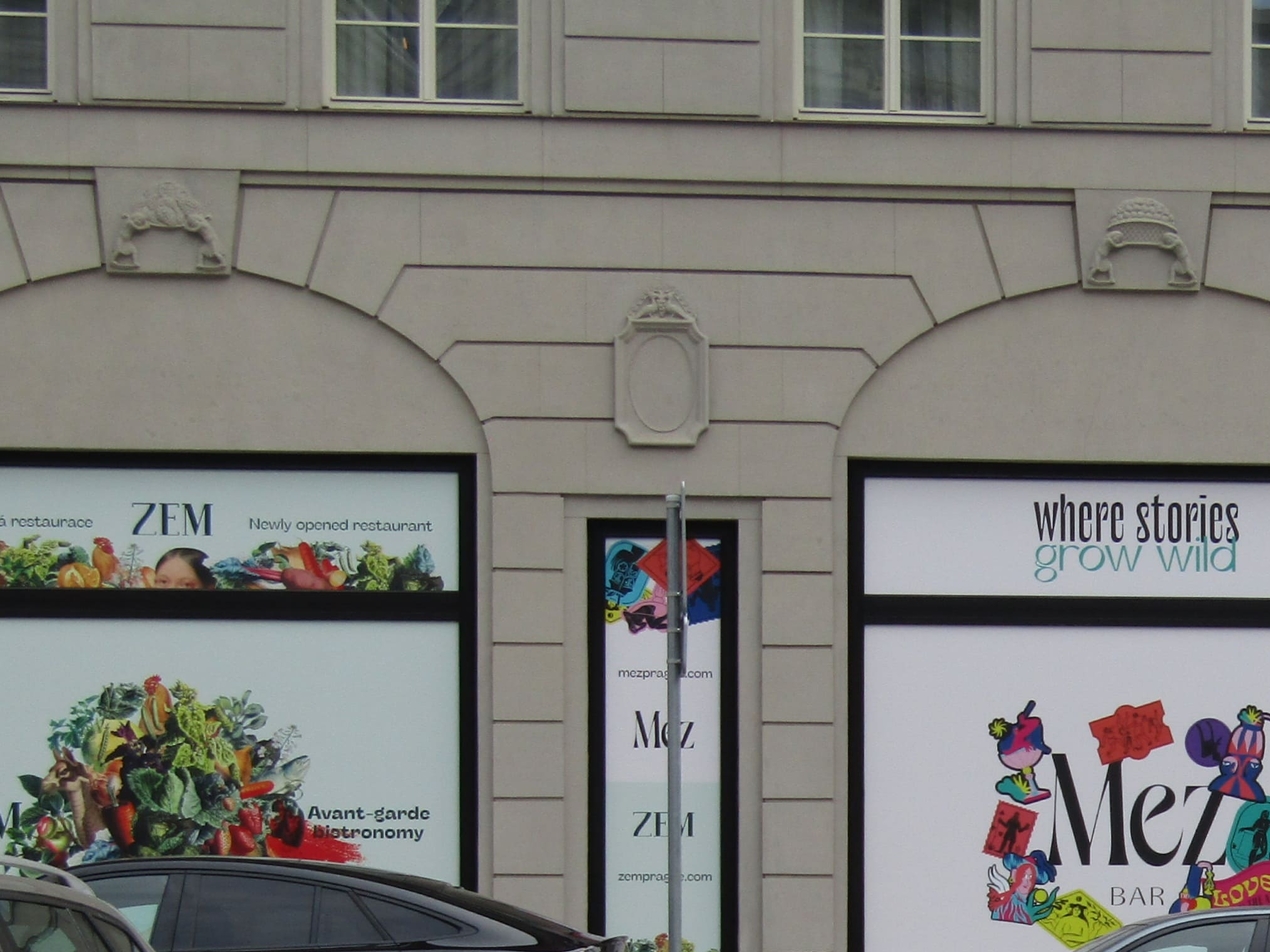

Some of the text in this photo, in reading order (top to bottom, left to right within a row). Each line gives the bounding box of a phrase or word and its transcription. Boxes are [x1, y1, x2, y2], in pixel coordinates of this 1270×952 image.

[11, 516, 94, 529] restaurace
[131, 503, 213, 537] ZEM
[249, 517, 433, 534] Newly opened restaurant
[1033, 493, 1240, 543] where stories
[1034, 536, 1236, 583] grow wild
[307, 805, 431, 823] Avant-garde
[1048, 753, 1227, 867] Mez
[313, 824, 424, 842] bistronomy
[1110, 886, 1165, 906] BAR
